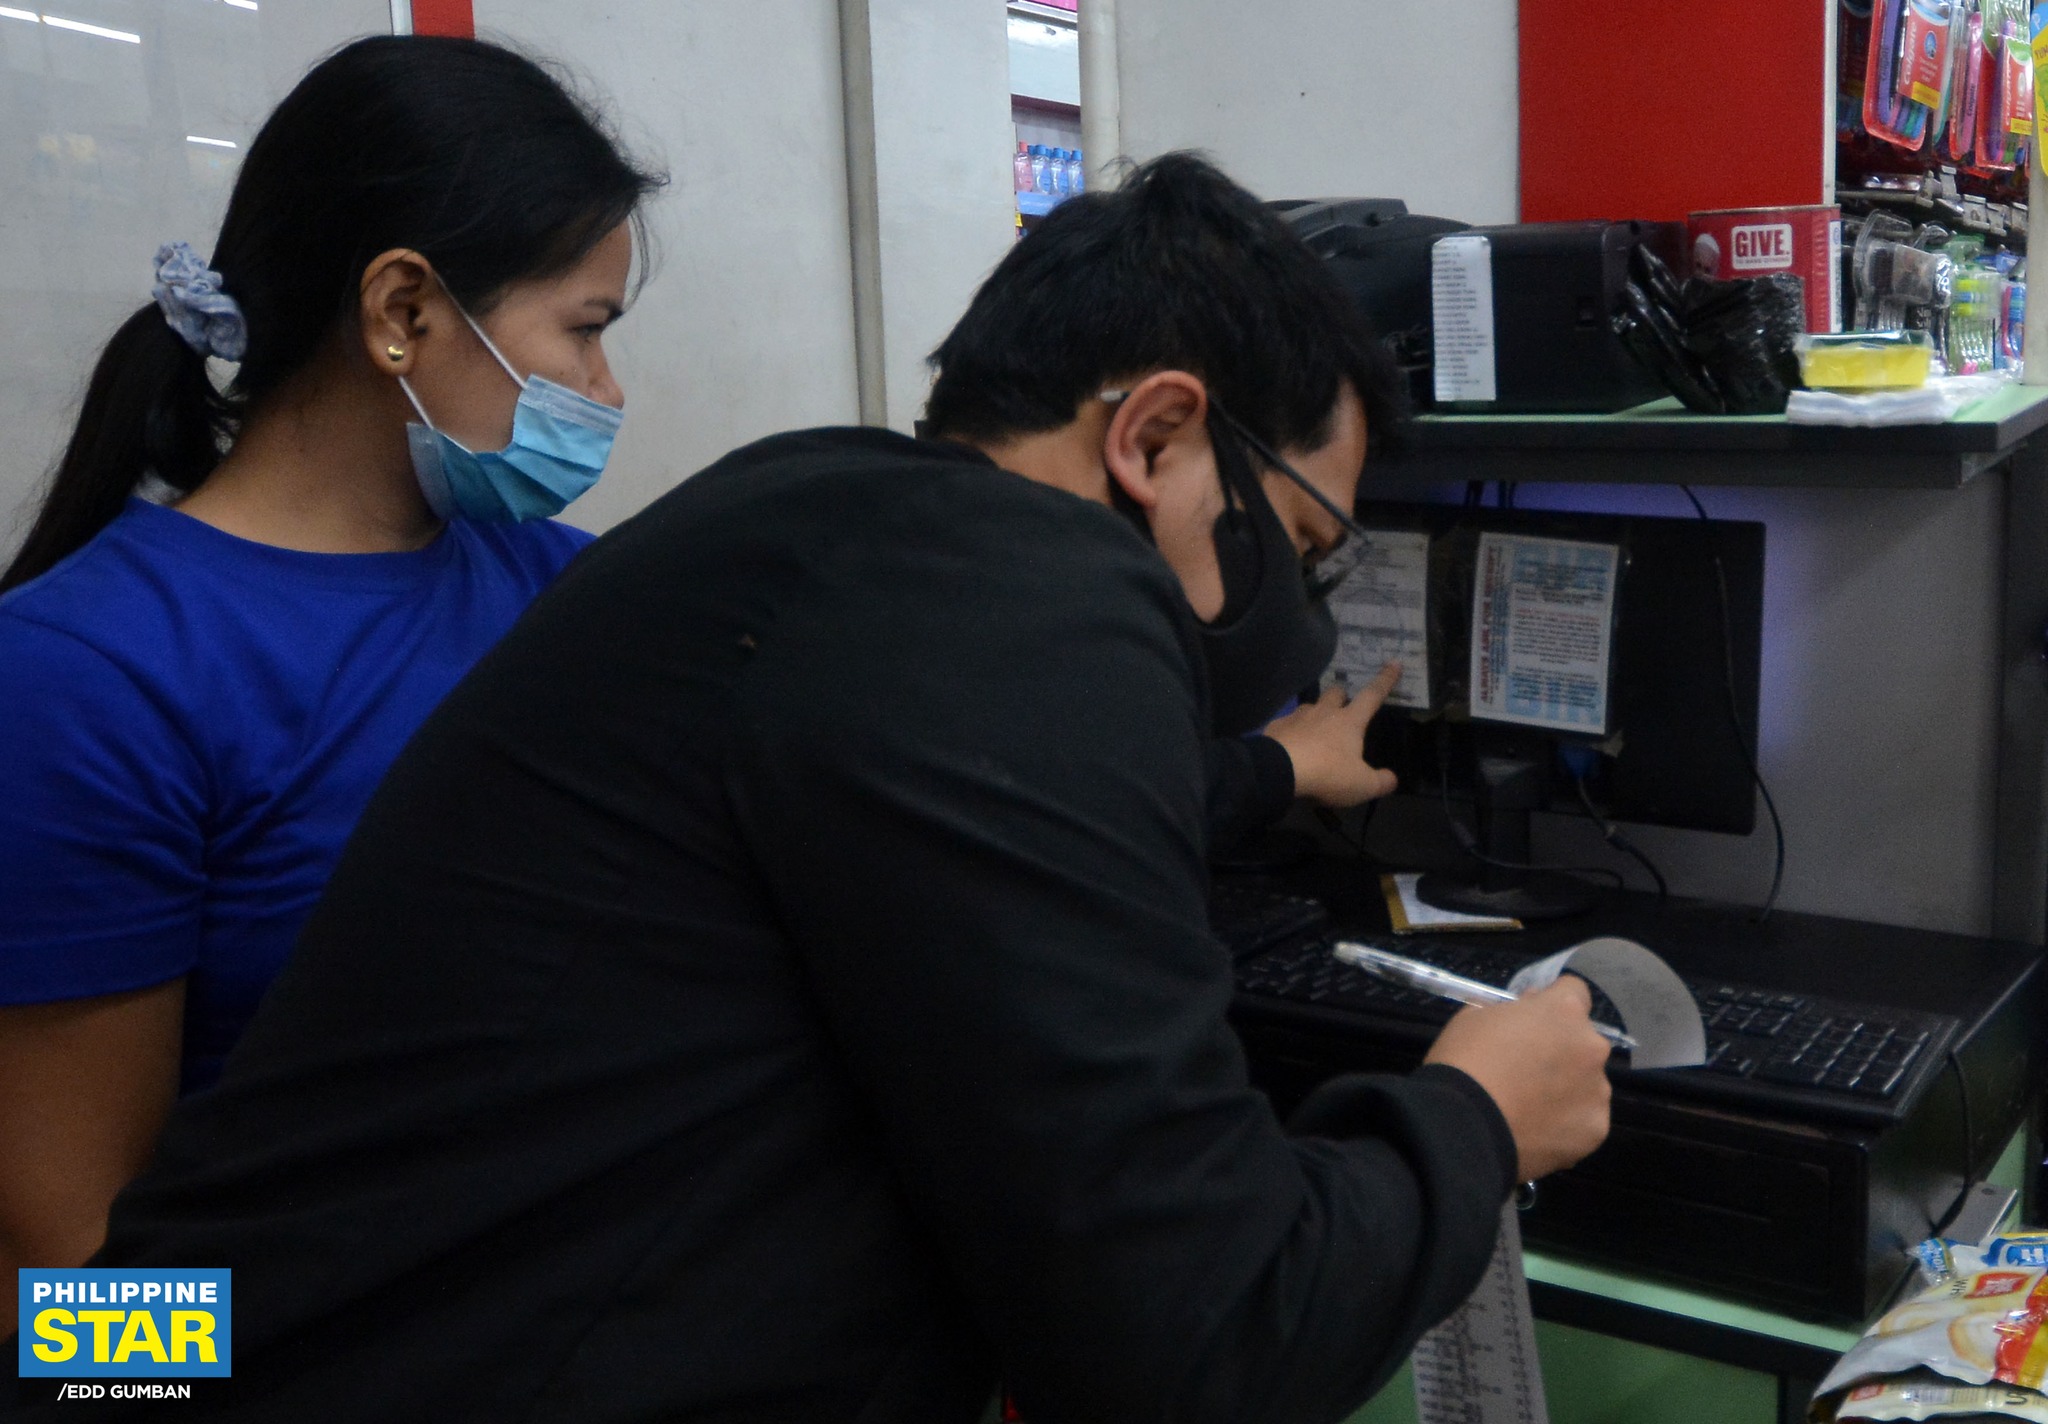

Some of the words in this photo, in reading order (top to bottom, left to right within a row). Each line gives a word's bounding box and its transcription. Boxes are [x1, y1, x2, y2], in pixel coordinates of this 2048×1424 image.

[1903, 21, 1918, 86] Colgate
[1967, 83, 1976, 117] Colgate
[1735, 229, 1790, 257] GIVE.
